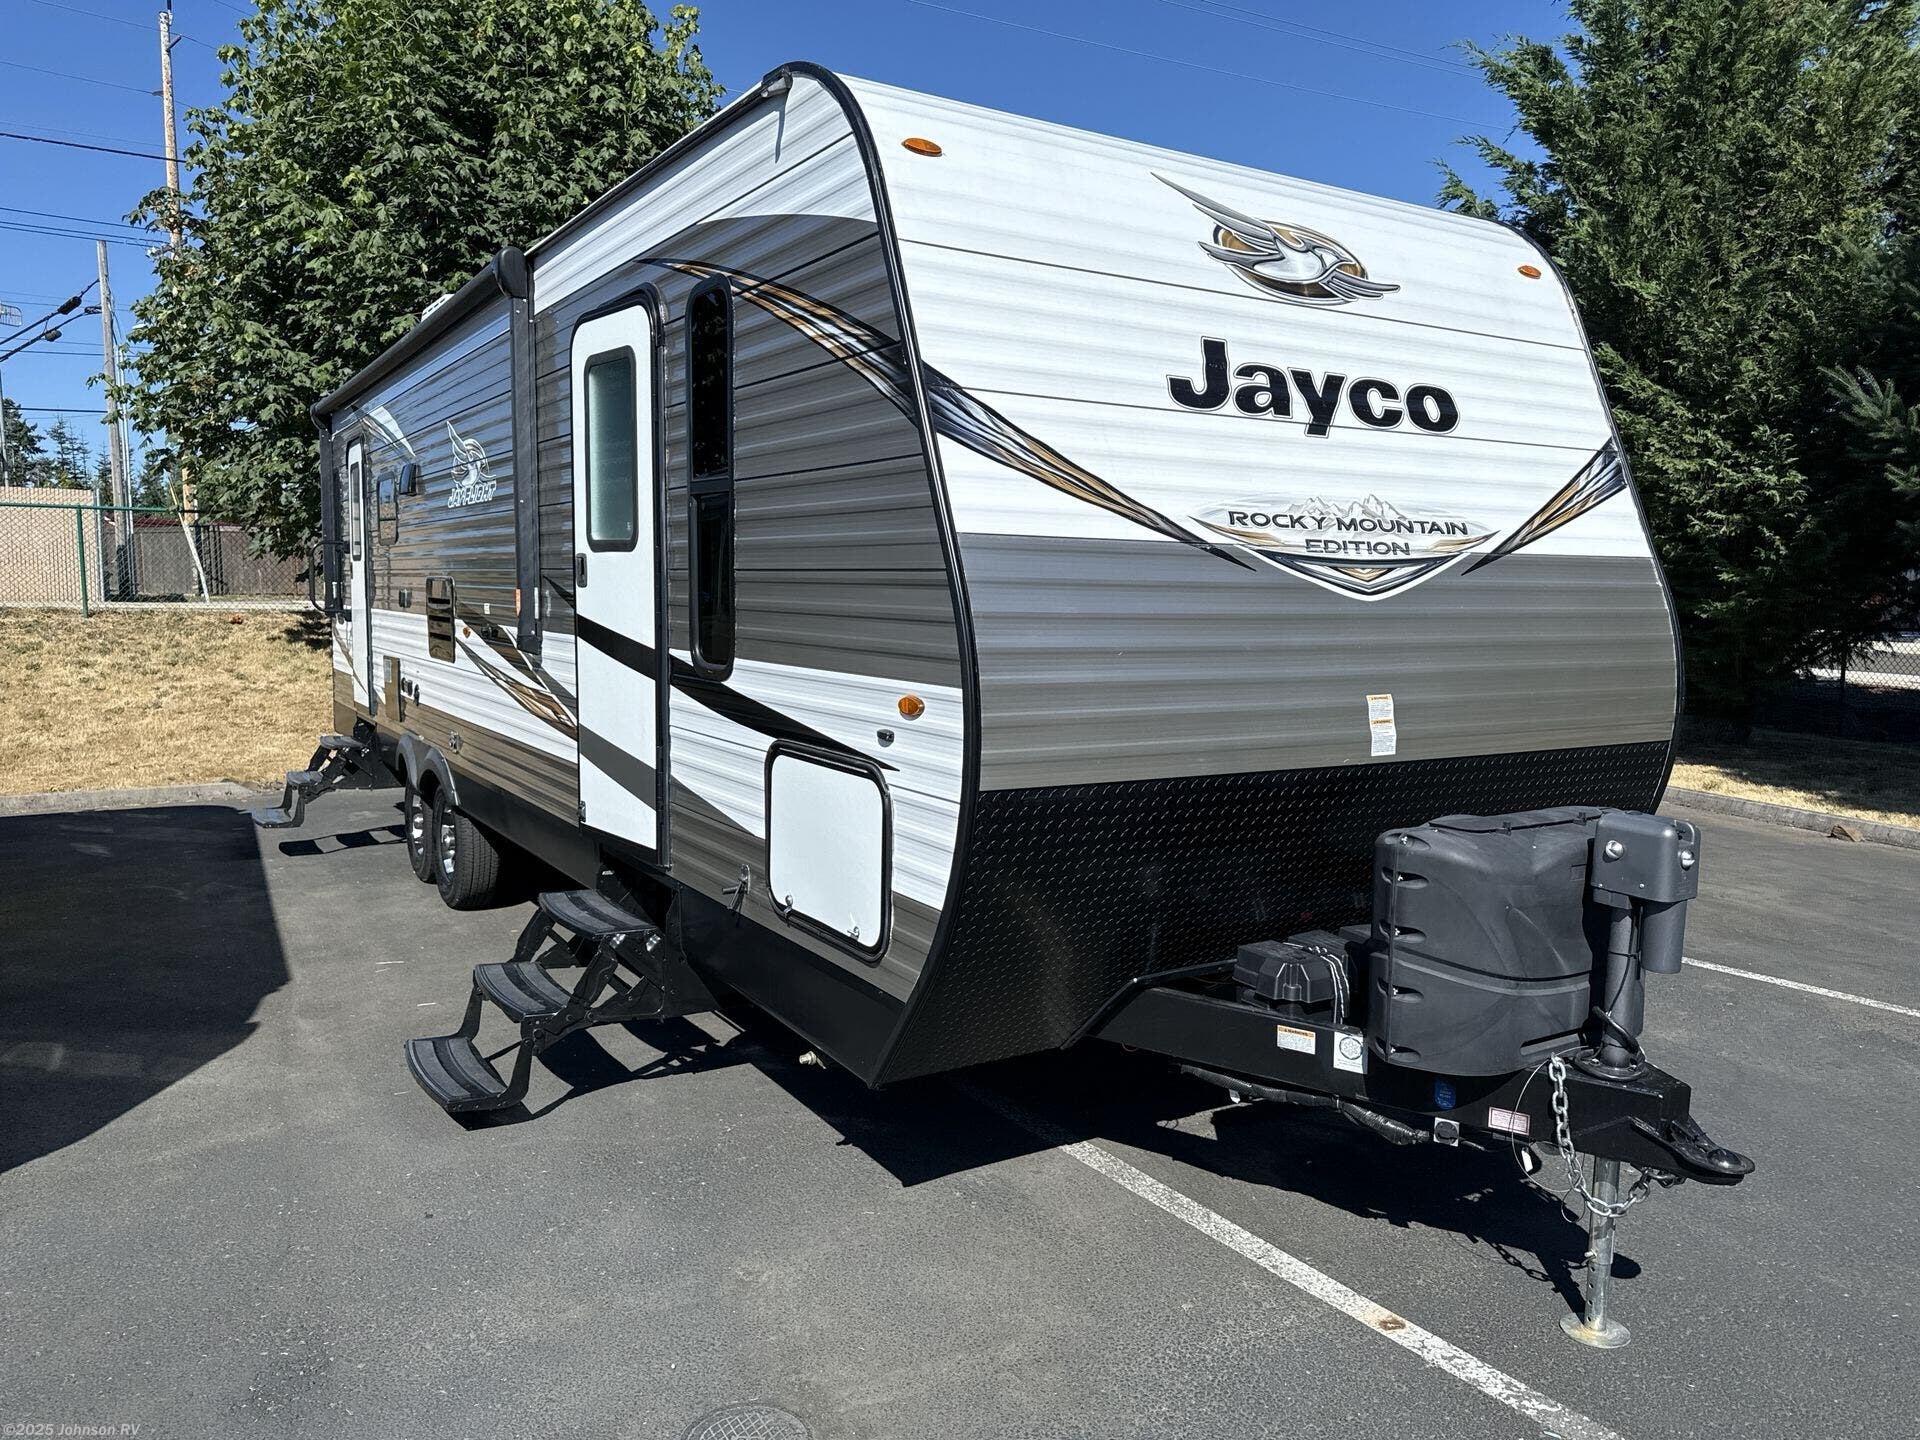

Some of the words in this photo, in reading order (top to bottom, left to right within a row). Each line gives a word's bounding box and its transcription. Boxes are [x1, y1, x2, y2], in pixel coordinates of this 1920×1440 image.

[1167, 337, 1460, 437] Jayco
[1228, 510, 1328, 530] ROCKY
[1336, 515, 1469, 536] MOUNTAIN
[1305, 538, 1410, 556] EDITION
